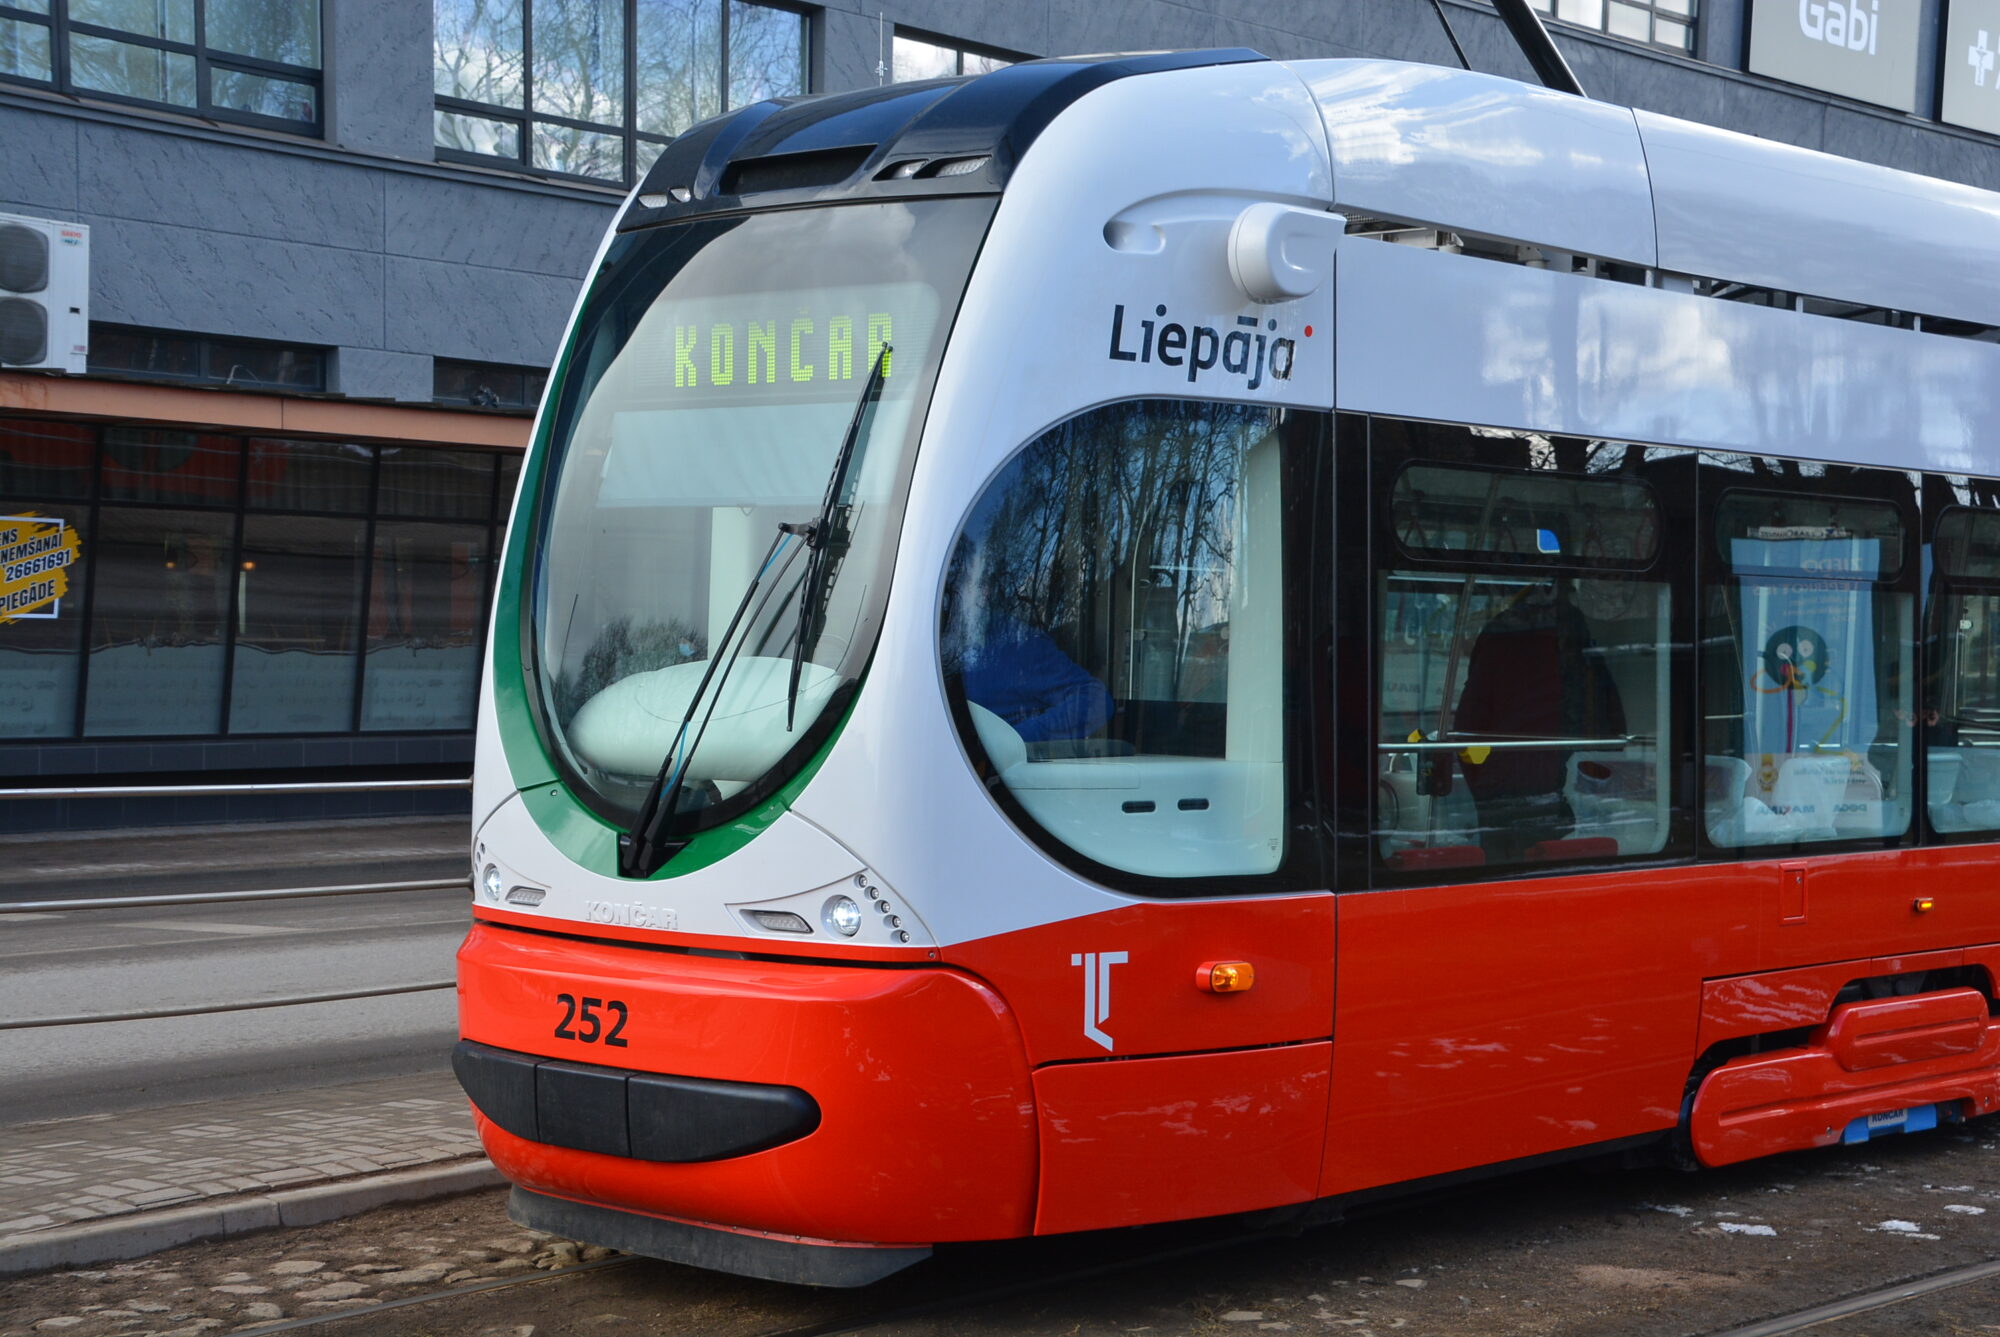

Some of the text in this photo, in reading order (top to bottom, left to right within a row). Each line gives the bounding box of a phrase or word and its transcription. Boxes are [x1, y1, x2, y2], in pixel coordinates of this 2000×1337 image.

[1799, 0, 1879, 56] Gabi
[1109, 304, 1296, 390] Liepāja
[5, 549, 71, 582] 26661691
[554, 993, 628, 1048] 252
